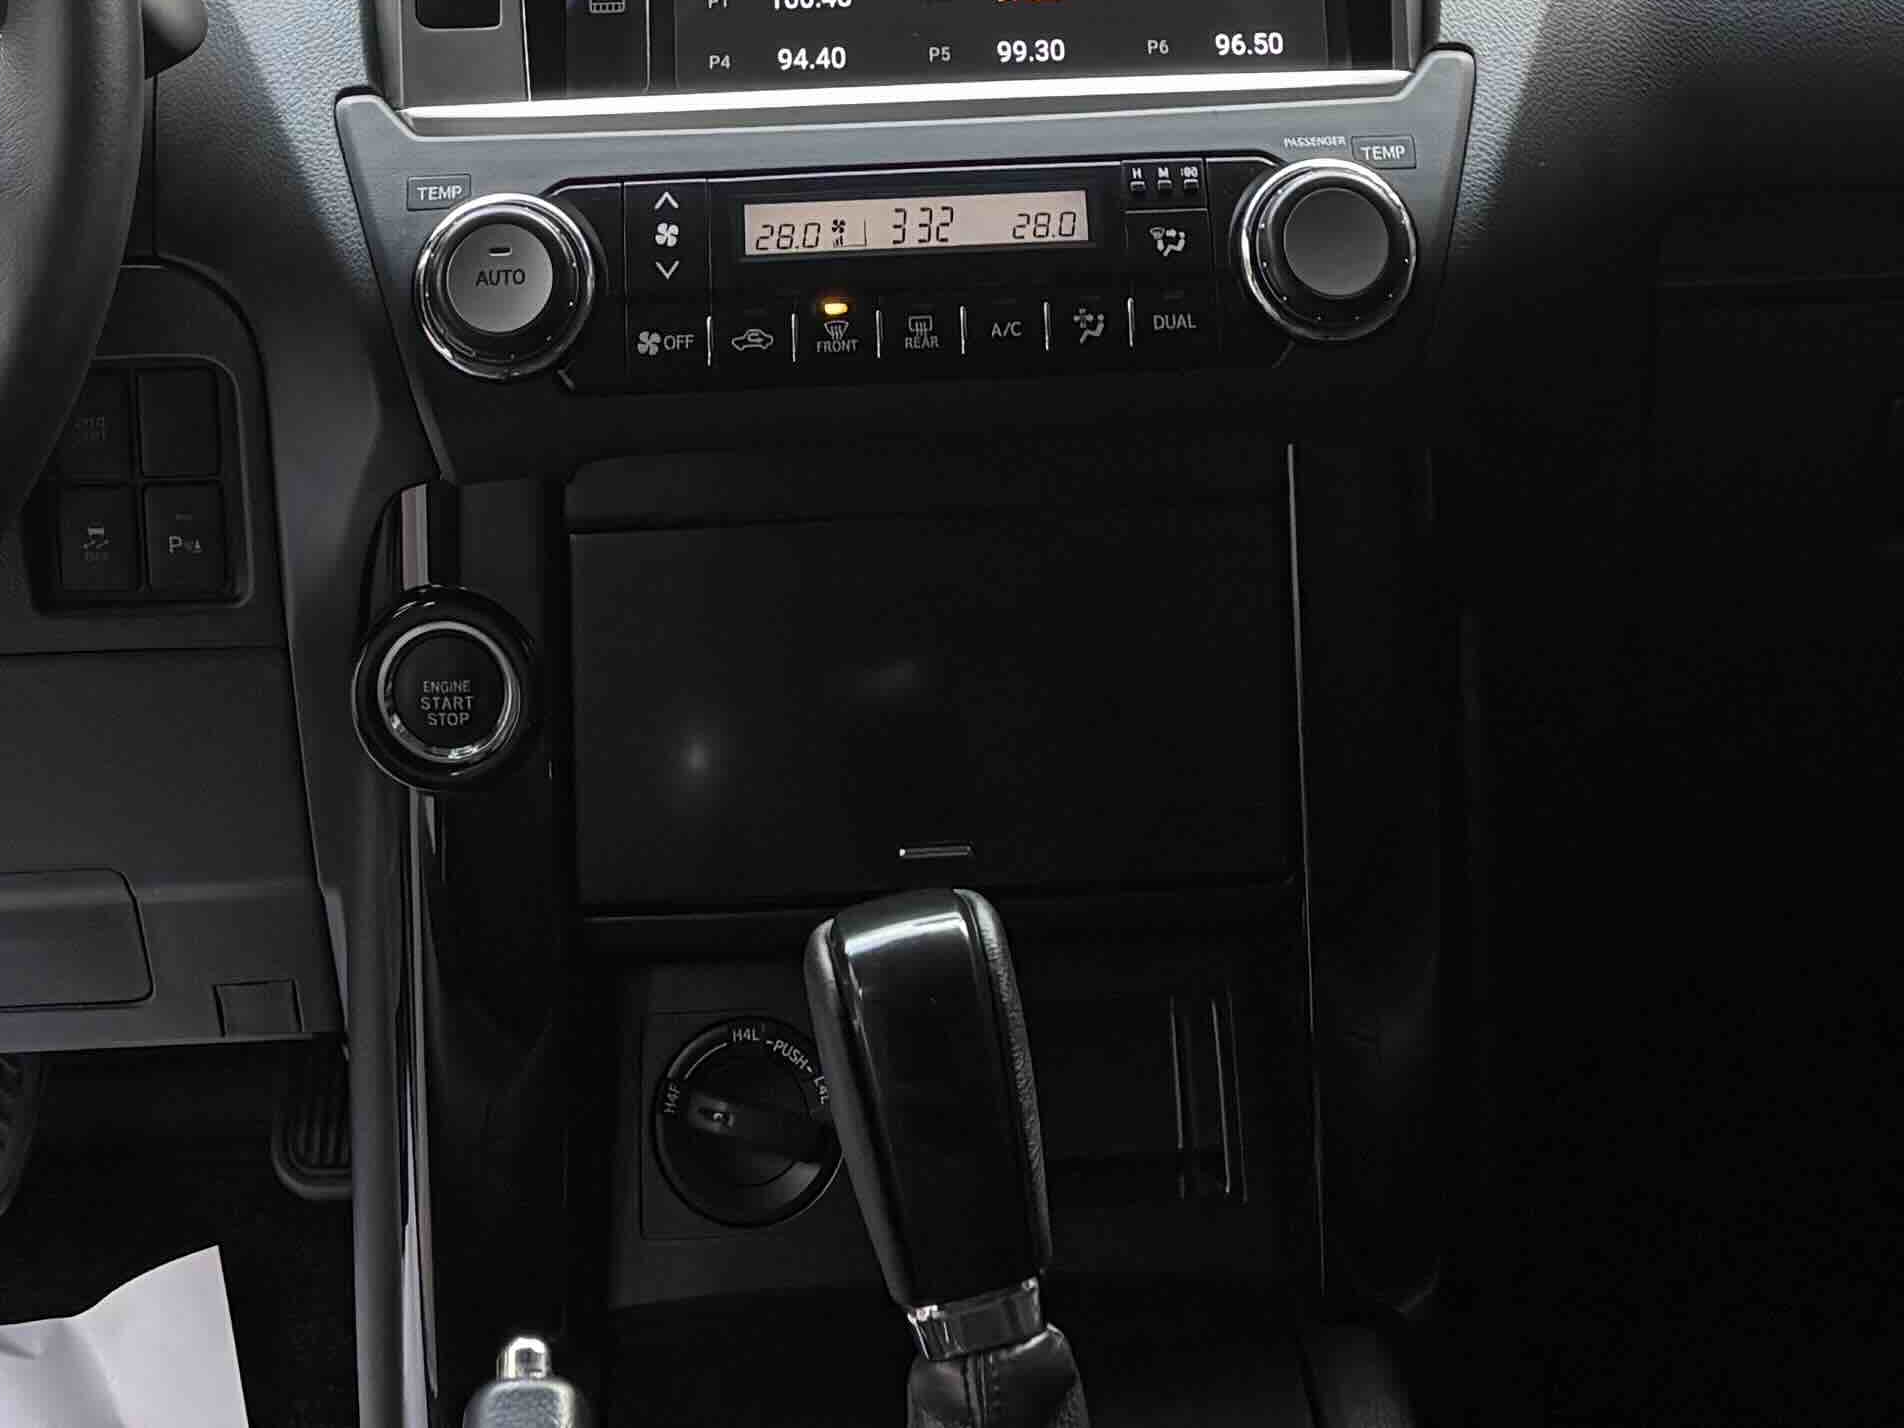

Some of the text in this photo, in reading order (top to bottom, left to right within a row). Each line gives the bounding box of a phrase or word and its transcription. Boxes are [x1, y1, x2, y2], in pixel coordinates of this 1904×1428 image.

[928, 38, 1066, 64] P5 99.30
[1146, 32, 1284, 58] P6 96.50
[709, 45, 847, 71] P4 94.40
[1283, 135, 1346, 149] PASSENGER
[1359, 144, 1406, 161] TEMP
[1132, 167, 1143, 179] H
[1157, 166, 1169, 178] M
[416, 185, 463, 201] TEMP
[755, 222, 821, 251] 28.0
[1012, 211, 1077, 240] 28.0
[475, 268, 526, 287] AUTO
[991, 321, 1024, 338] A/C
[1152, 313, 1198, 330] DUAL
[663, 334, 696, 351] OFF
[816, 339, 859, 354] FRONT
[904, 334, 940, 350] REAR
[423, 679, 472, 693] ENGINE
[420, 695, 475, 711] START
[427, 712, 471, 726] STOP
[731, 1027, 761, 1043] H4L
